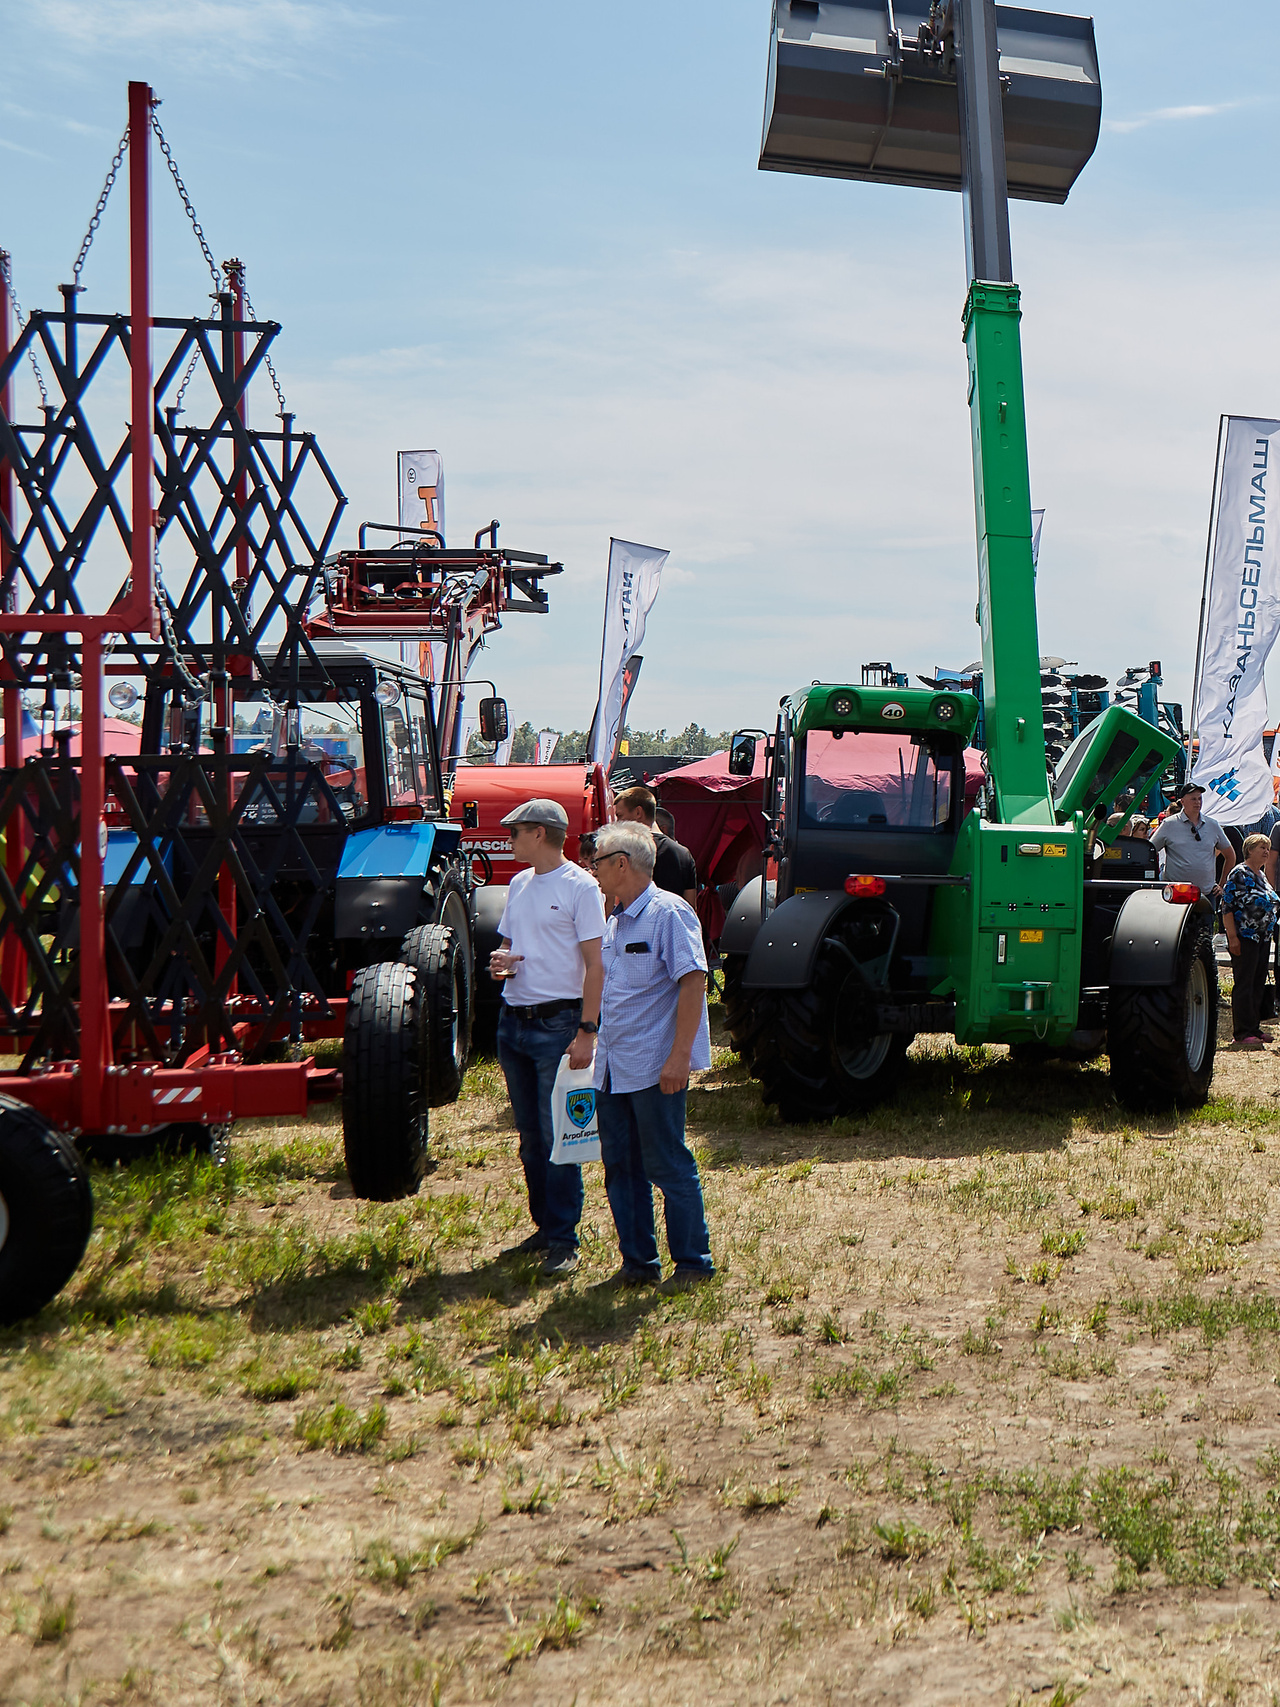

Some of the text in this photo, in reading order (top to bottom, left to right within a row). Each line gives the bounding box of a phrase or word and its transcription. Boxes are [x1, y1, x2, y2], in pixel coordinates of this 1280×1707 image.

[1223, 438, 1269, 739] КАЗАНЬСЕЛЬМАШ
[884, 709, 902, 717] 40
[461, 841, 512, 850] MASCH
